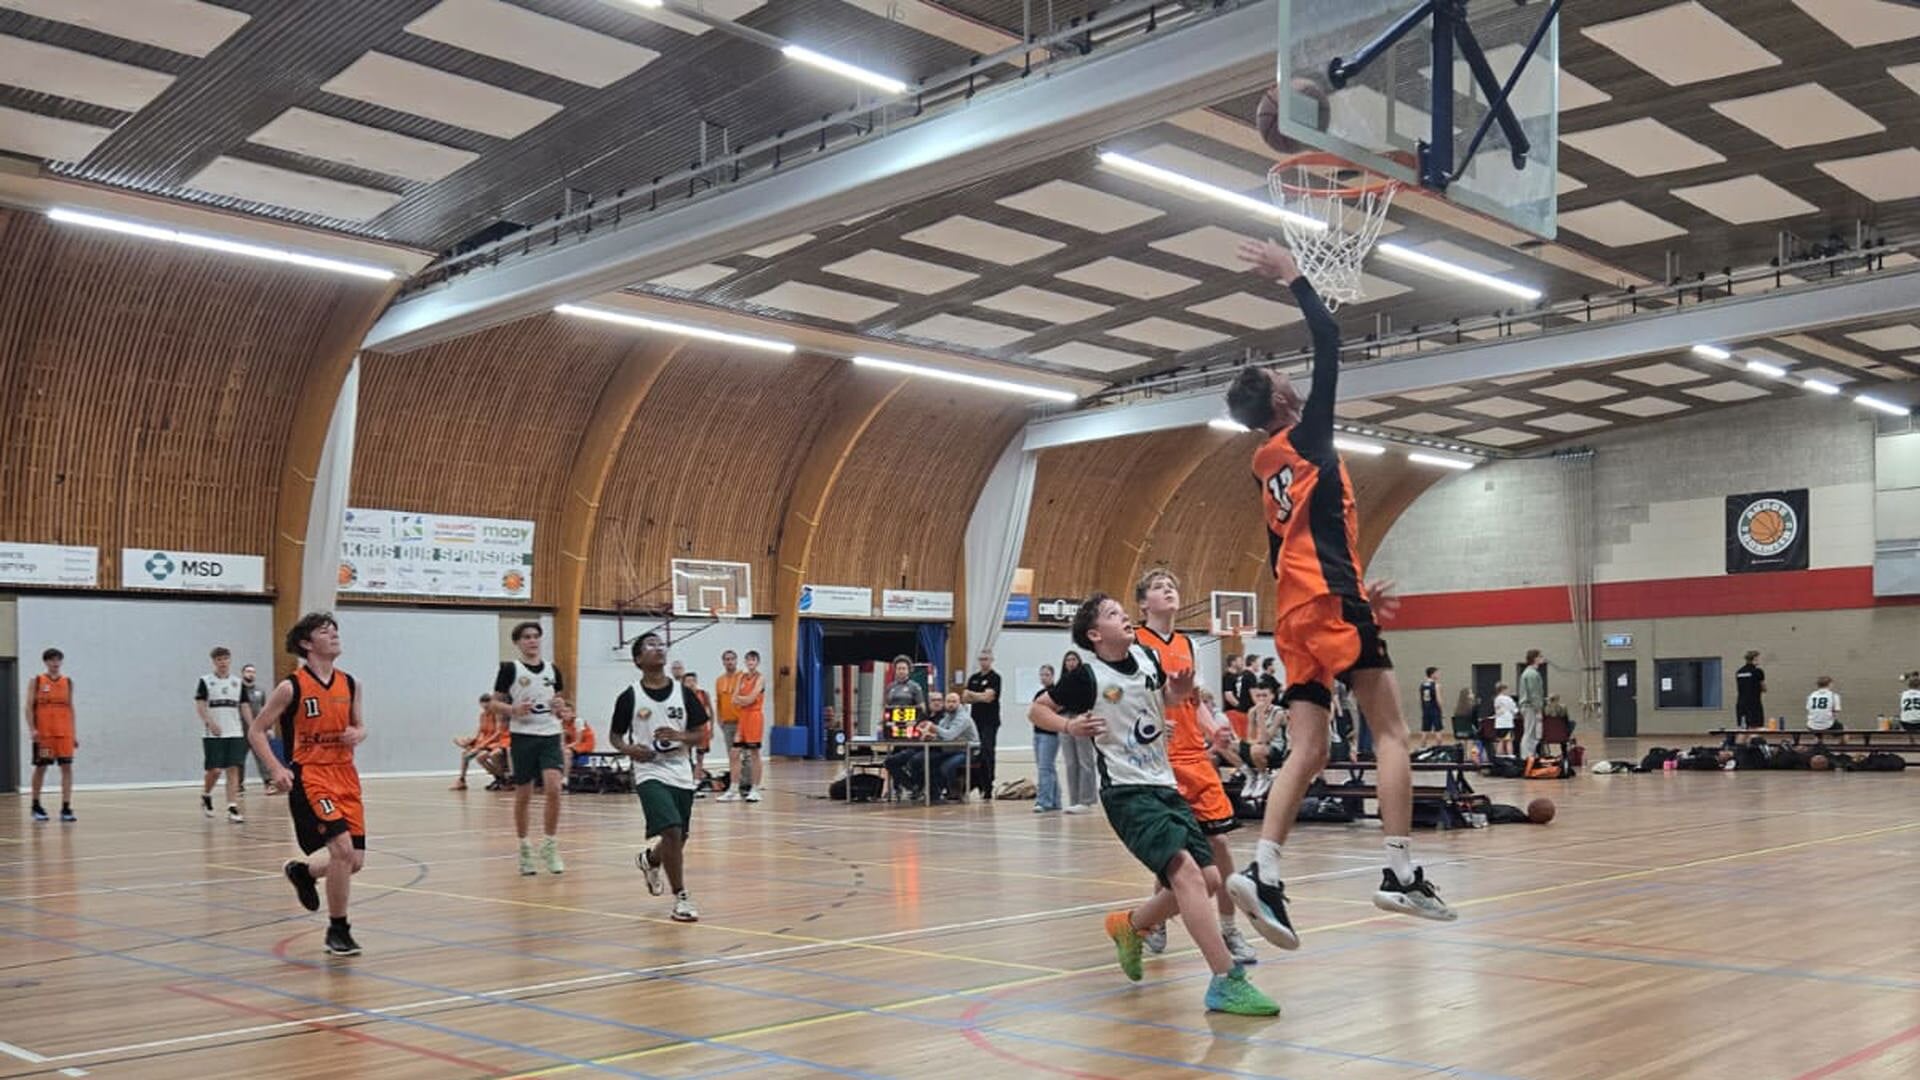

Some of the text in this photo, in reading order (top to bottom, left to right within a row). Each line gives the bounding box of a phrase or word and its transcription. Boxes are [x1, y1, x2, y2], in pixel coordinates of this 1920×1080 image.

[340, 542, 394, 559] KROS
[181, 560, 223, 577] MSD
[304, 697, 320, 718] 11
[1811, 697, 1829, 710] 18
[1904, 698, 1920, 711] 25
[319, 798, 335, 815] 11
